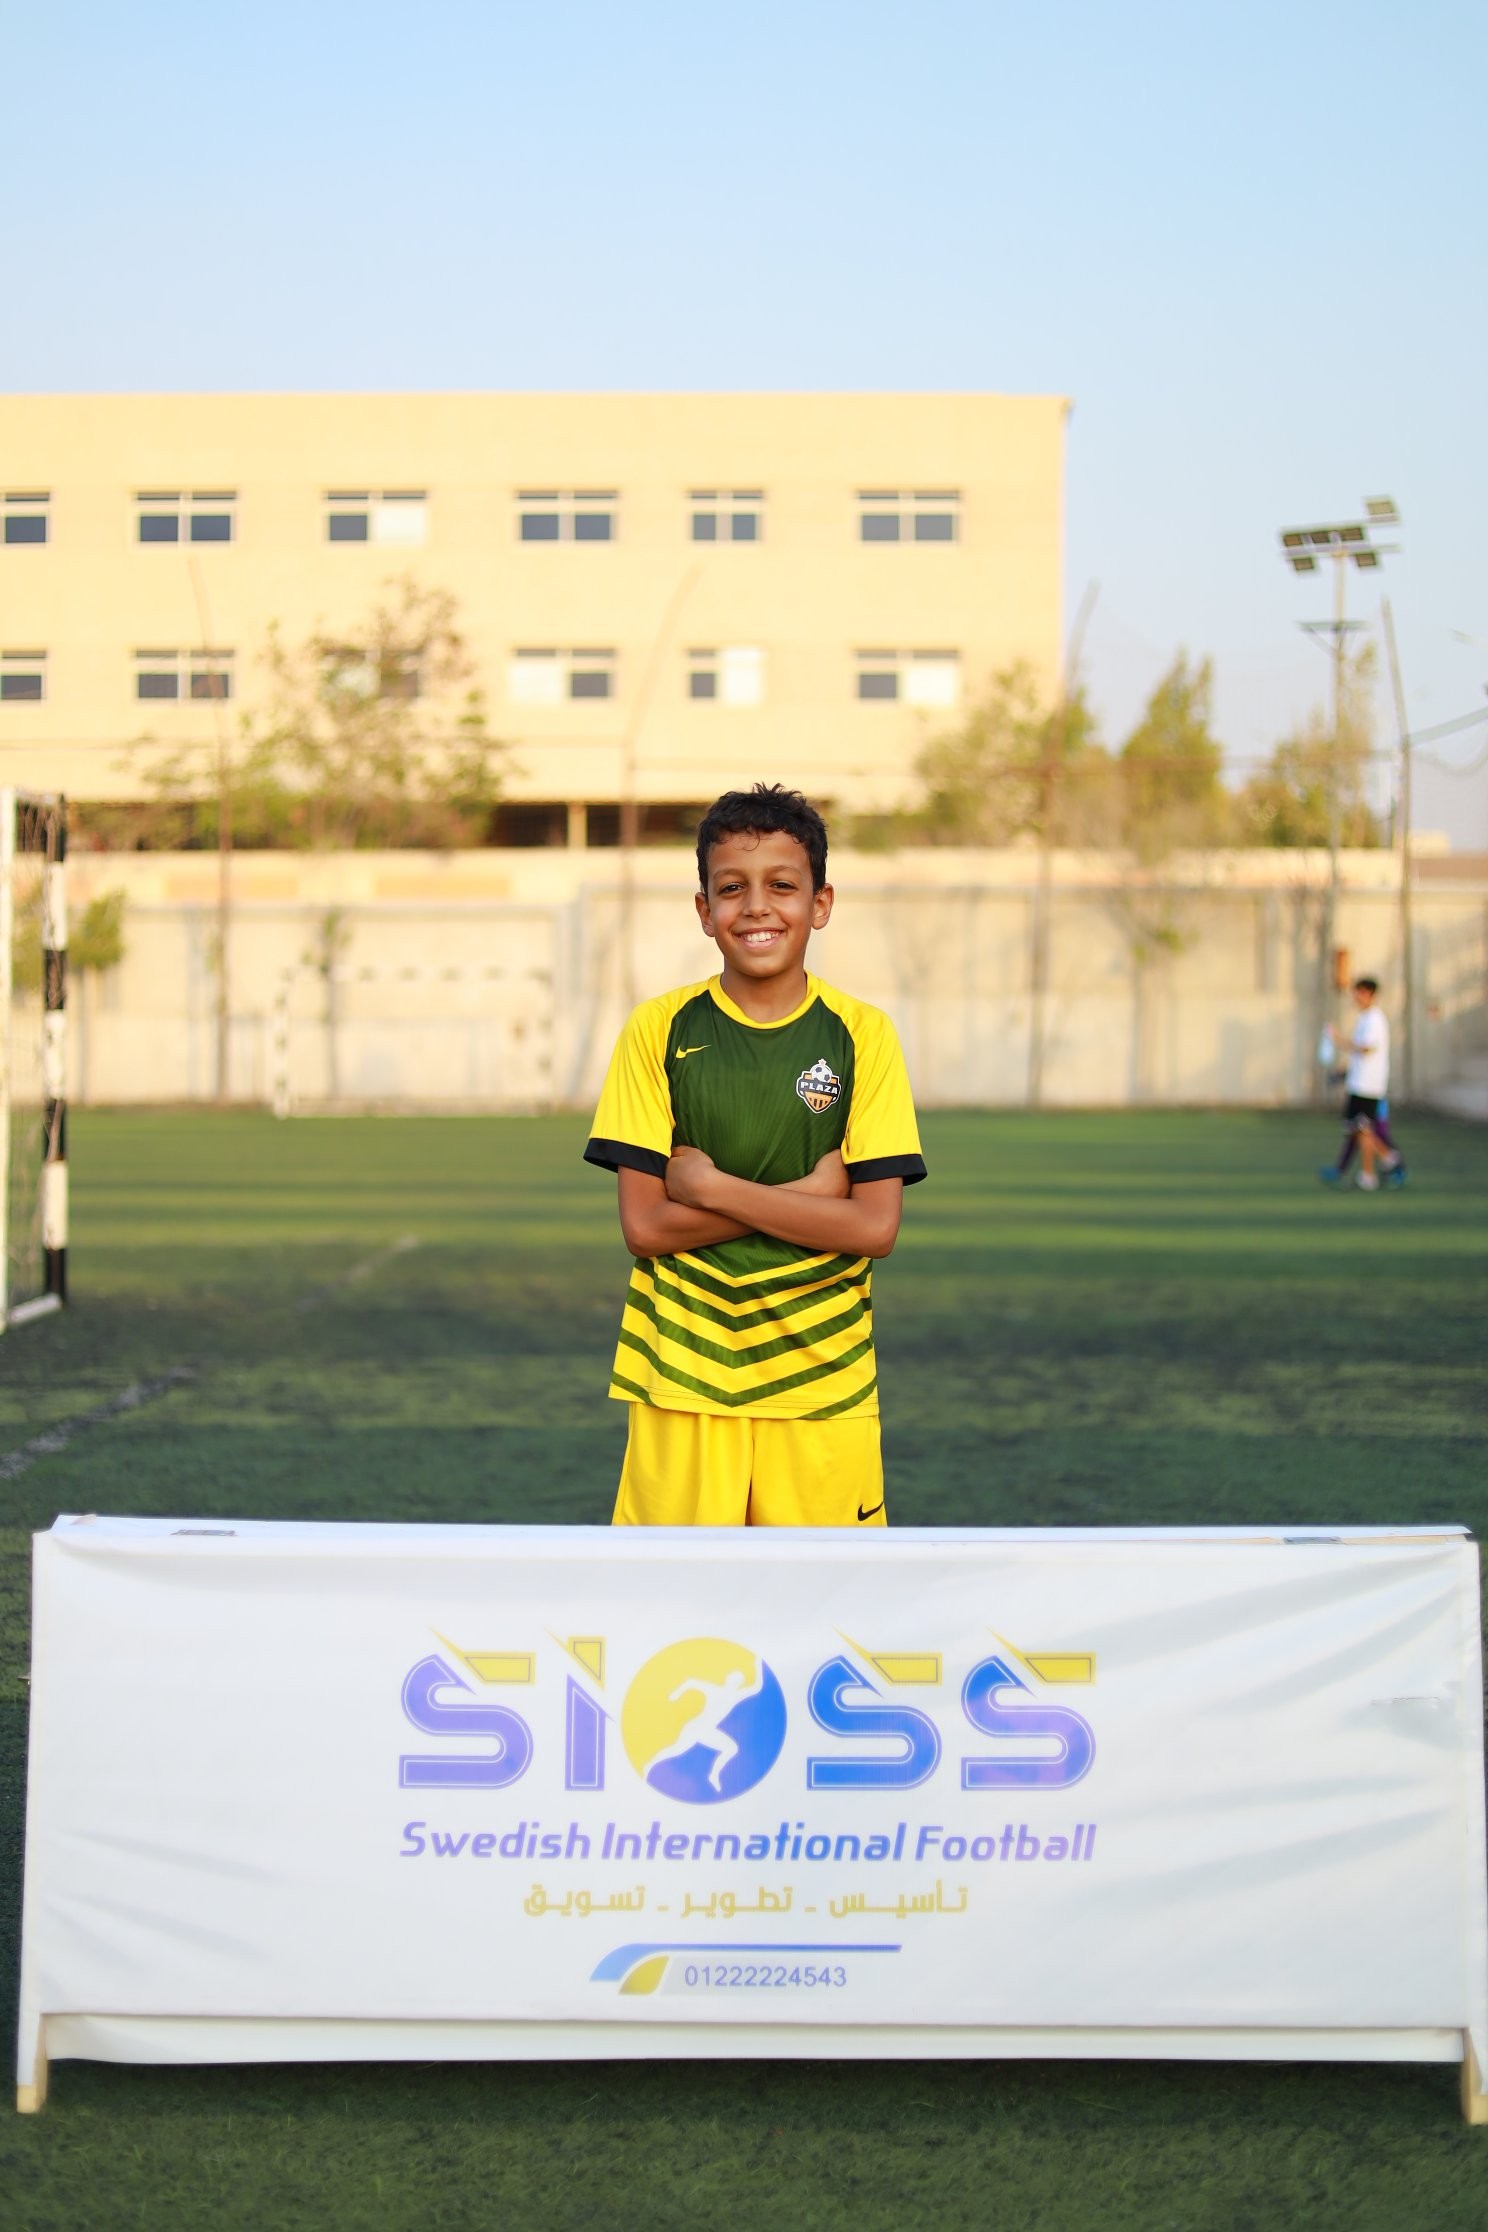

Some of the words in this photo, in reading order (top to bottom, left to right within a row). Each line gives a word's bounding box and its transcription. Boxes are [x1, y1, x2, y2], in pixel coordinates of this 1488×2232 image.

[800, 1081, 838, 1094] PLAZA
[400, 1820, 591, 1859] Swedish
[600, 1821, 907, 1861] International
[914, 1823, 1097, 1862] Football
[684, 1965, 847, 1987] 01222224543
